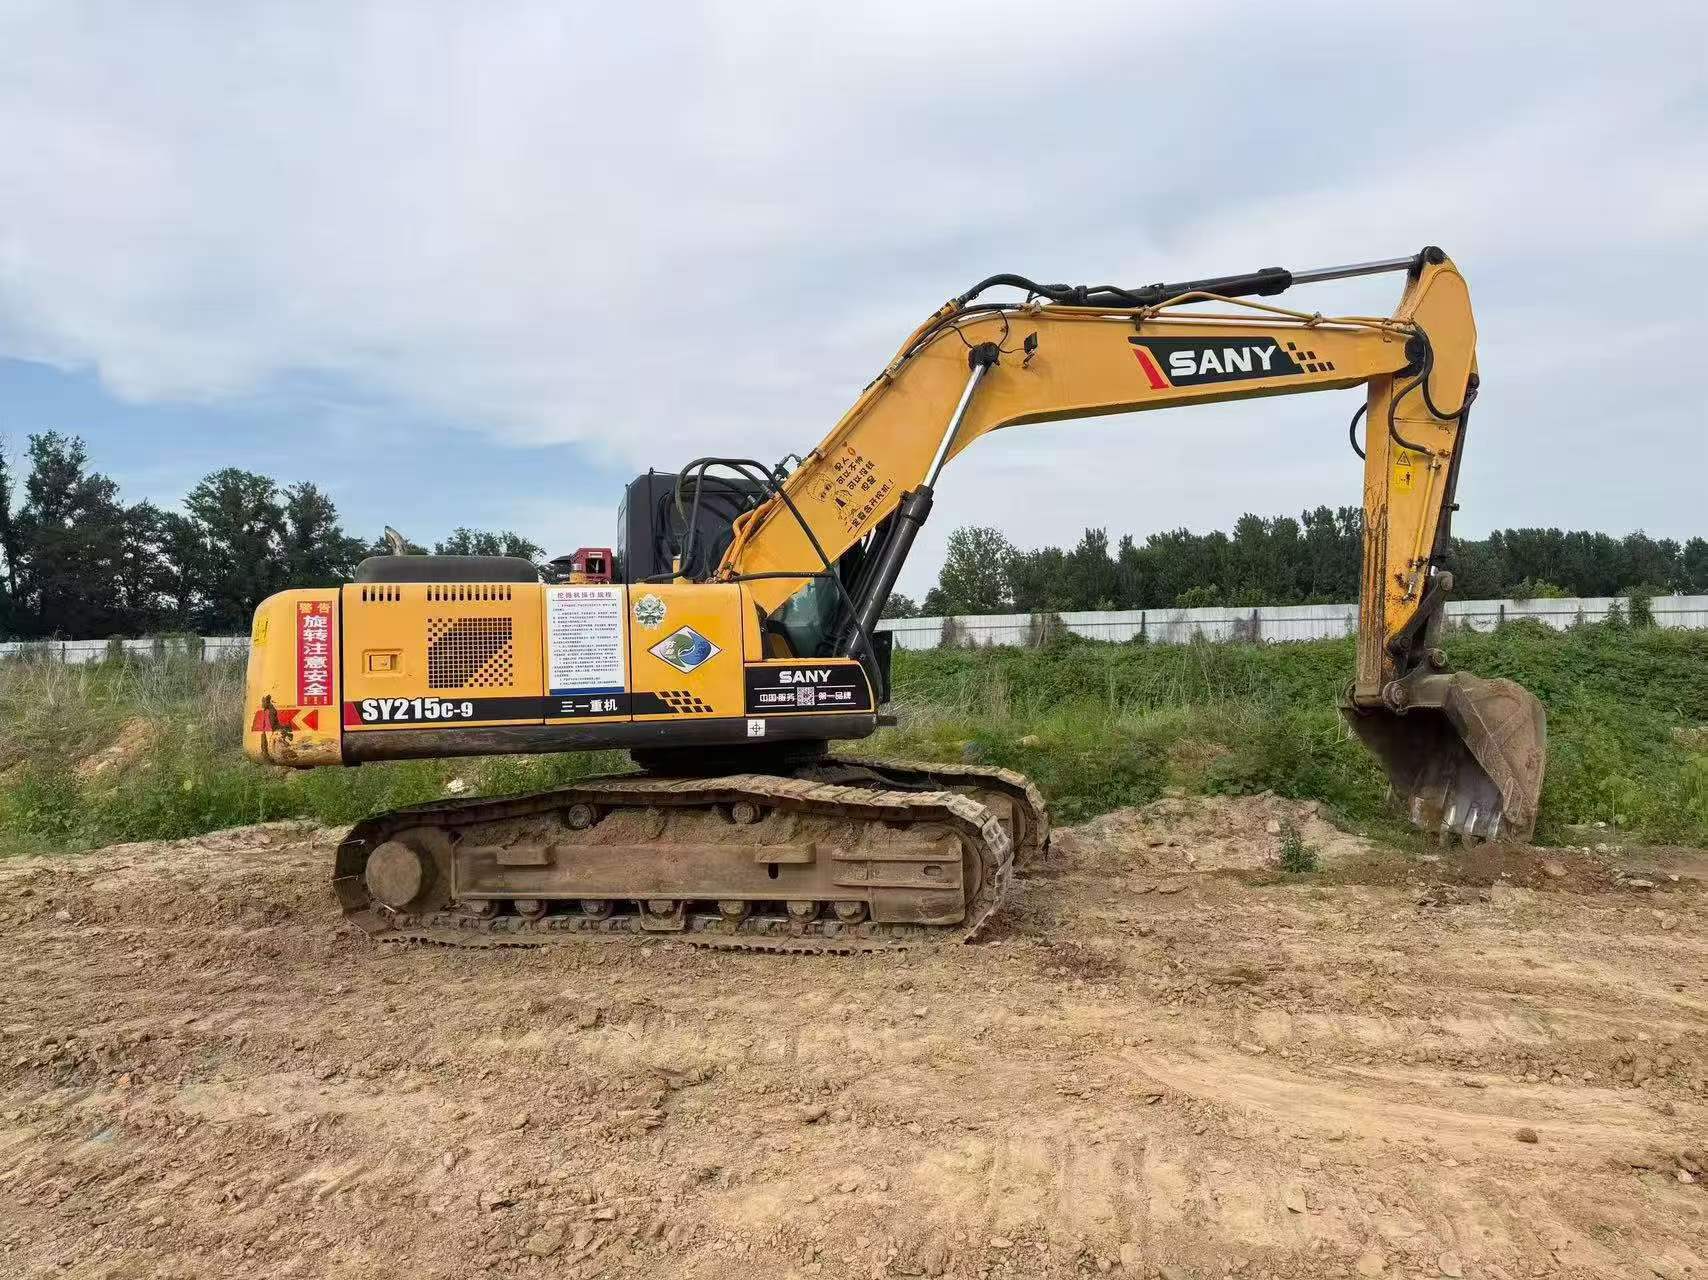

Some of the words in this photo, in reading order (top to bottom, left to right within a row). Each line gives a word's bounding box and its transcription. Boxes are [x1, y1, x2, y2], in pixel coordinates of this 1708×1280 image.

[1168, 345, 1277, 377] SANY
[834, 456, 850, 471] 男人
[836, 456, 864, 485] 可以不帅
[847, 460, 876, 490] 可以没钱
[299, 602, 331, 613] 警告
[303, 615, 328, 696] 旋转注意安全
[779, 669, 832, 684] SANY
[818, 691, 852, 701] 第一品牌
[362, 697, 474, 721] SY215C-9
[560, 699, 618, 713] 三一重机
